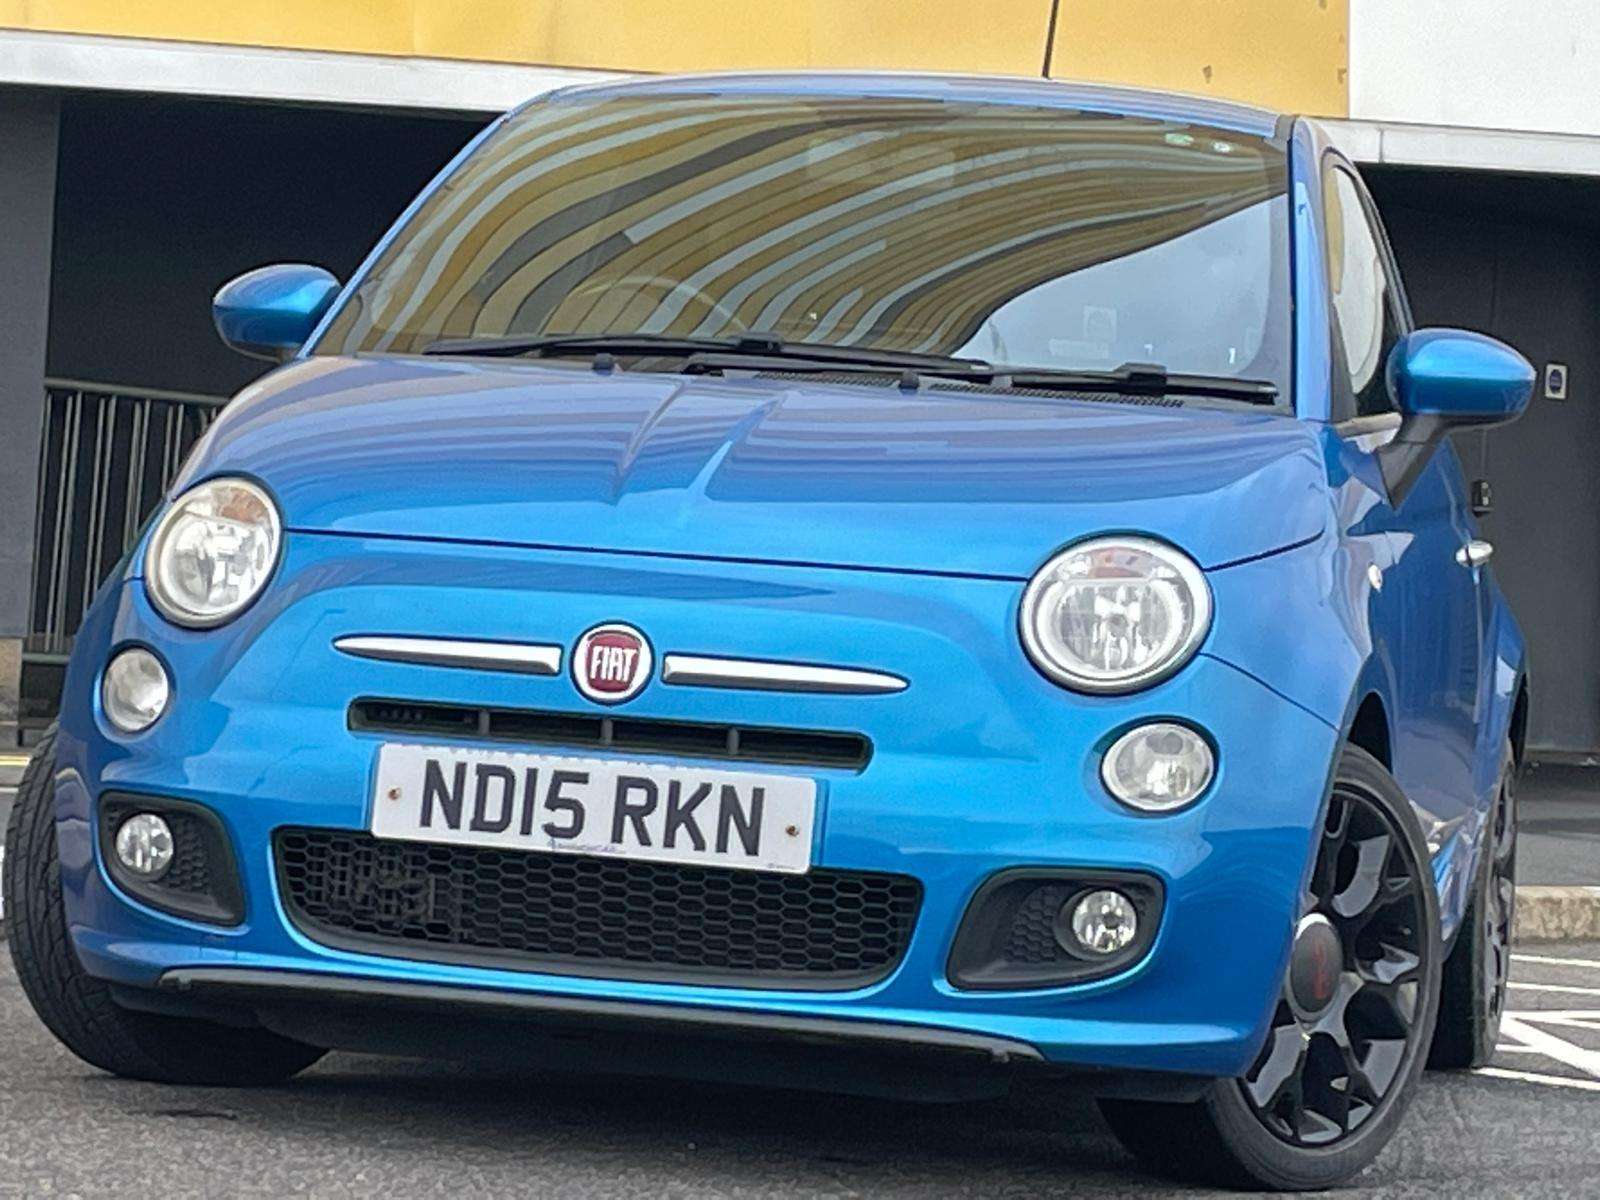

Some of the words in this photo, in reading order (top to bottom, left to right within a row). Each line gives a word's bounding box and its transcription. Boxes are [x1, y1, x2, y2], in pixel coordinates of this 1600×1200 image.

[590, 645, 637, 682] FIAT
[420, 759, 589, 839] ND15
[611, 775, 765, 856] RKN
